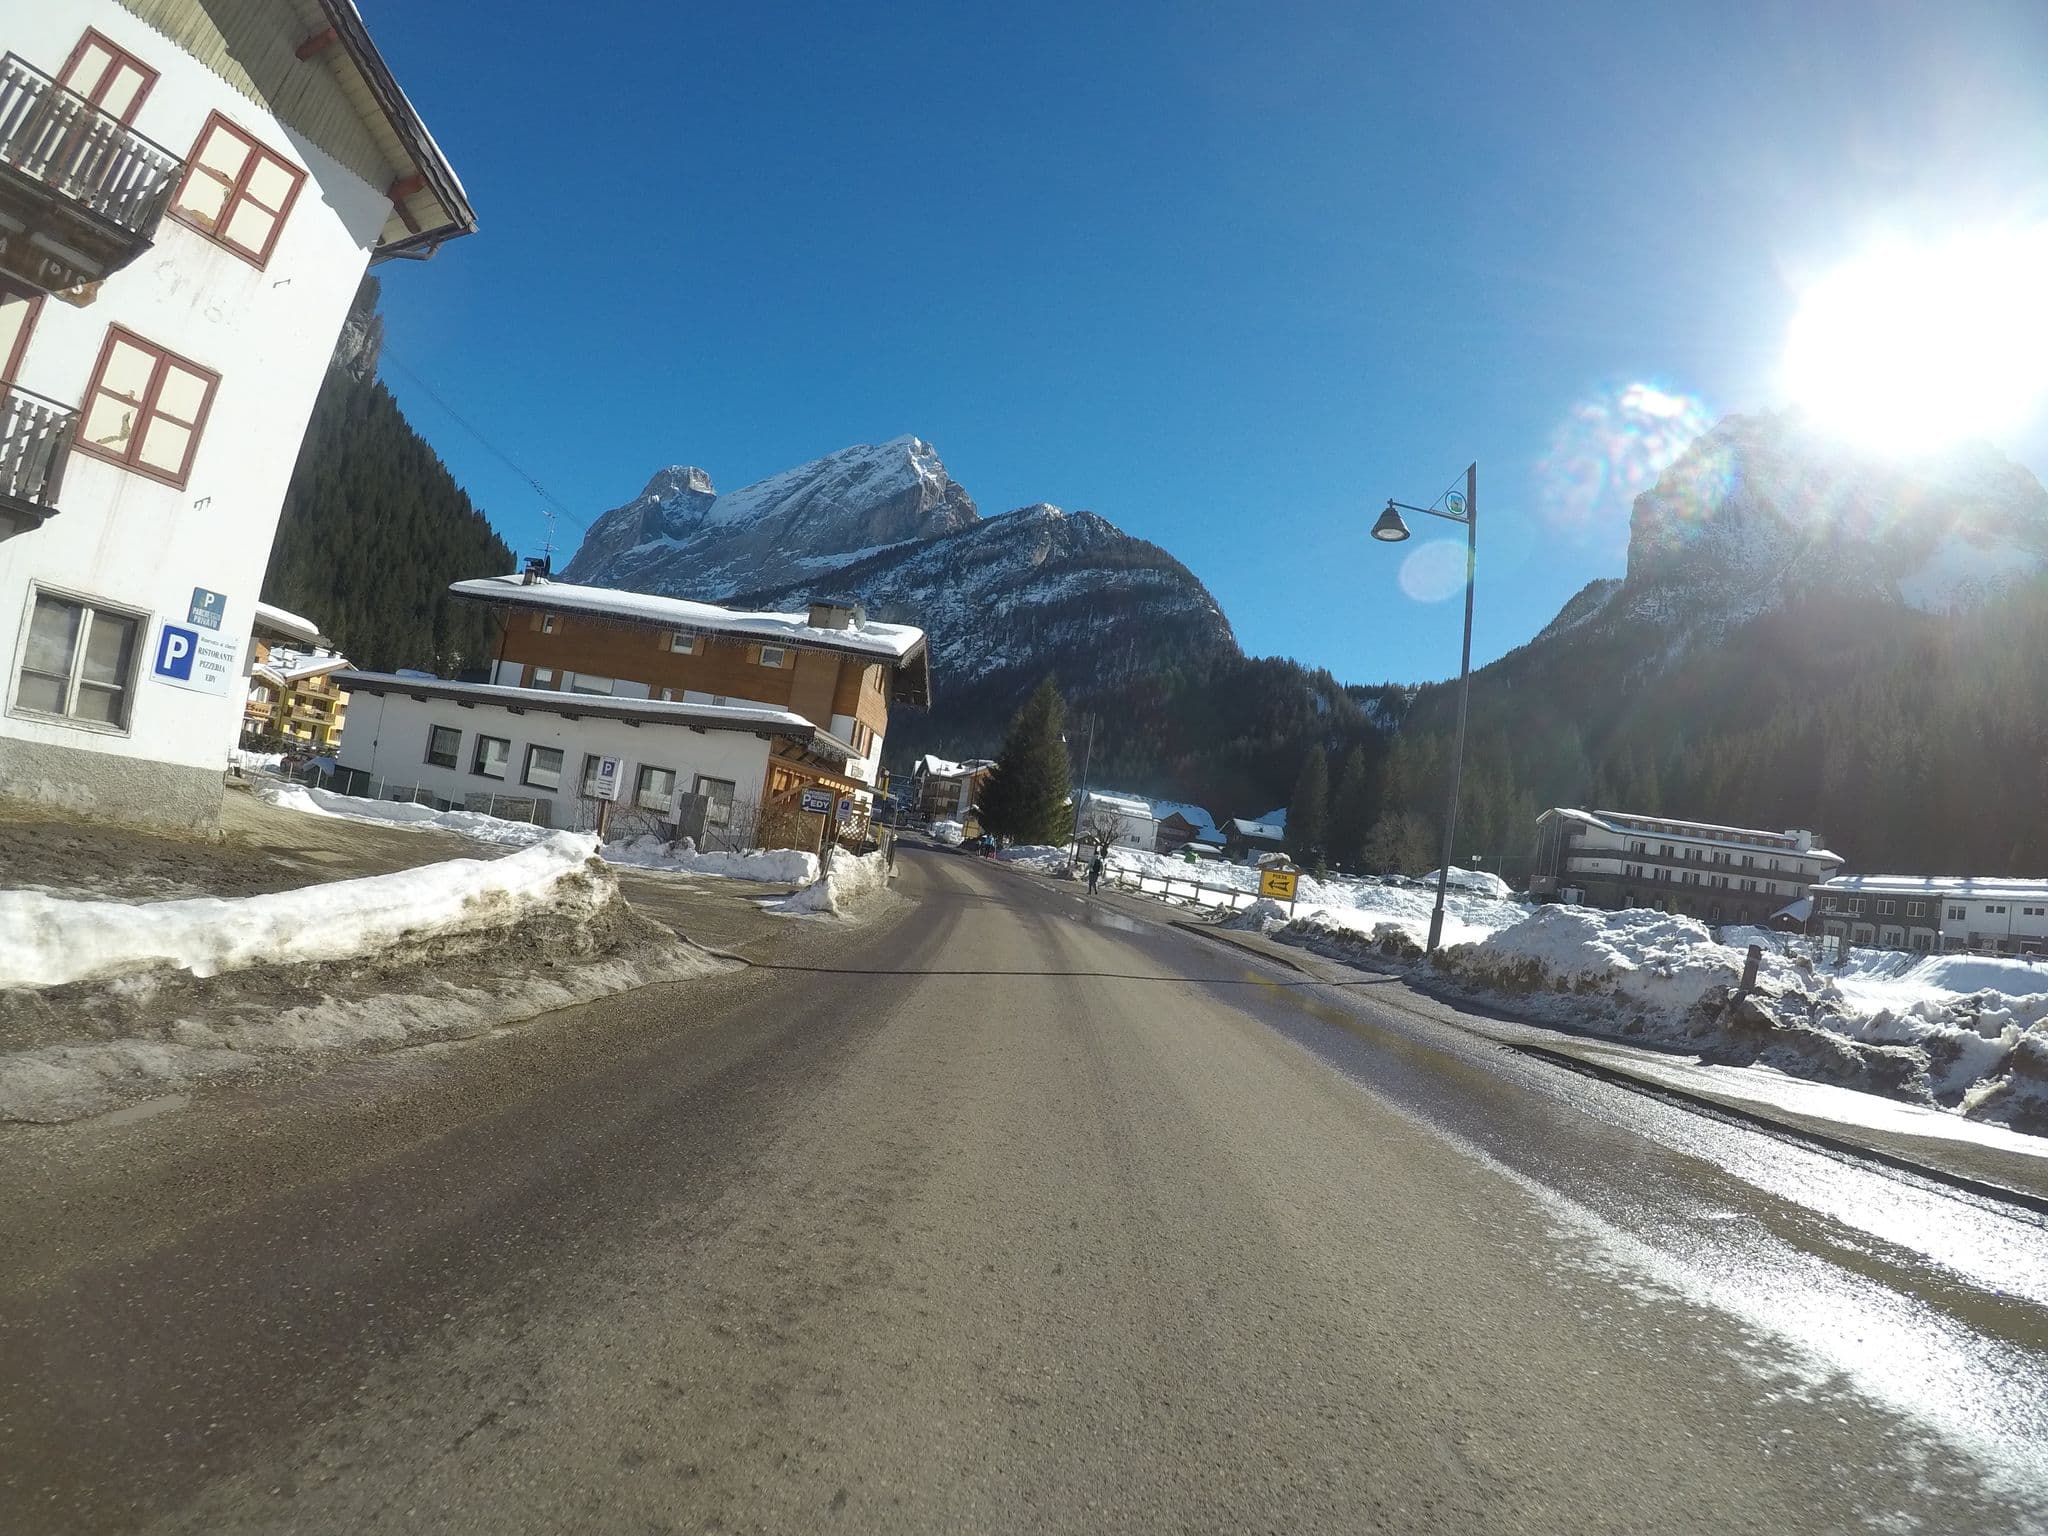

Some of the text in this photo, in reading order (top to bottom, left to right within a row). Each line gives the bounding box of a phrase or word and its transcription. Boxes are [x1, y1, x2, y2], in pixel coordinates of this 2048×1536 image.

[204, 593, 215, 608] P
[163, 633, 189, 670] P
[198, 646, 234, 663] RISTORANTE
[199, 659, 226, 673] PIZZERIA
[604, 763, 612, 774] P
